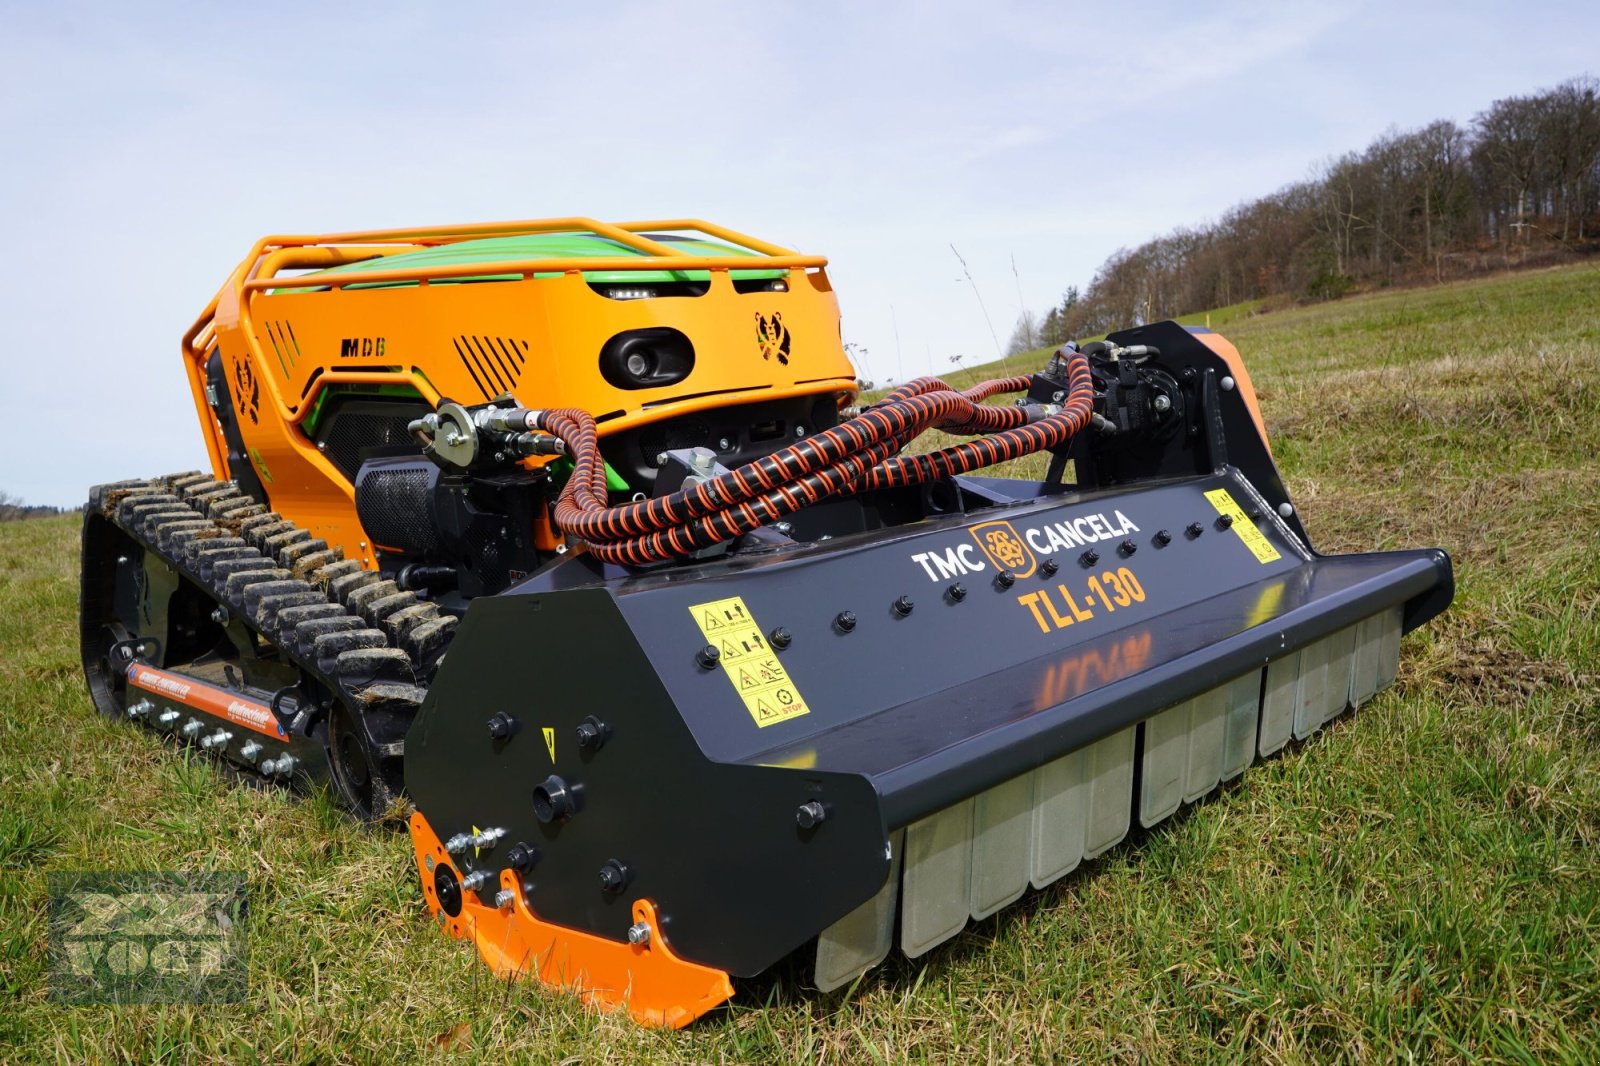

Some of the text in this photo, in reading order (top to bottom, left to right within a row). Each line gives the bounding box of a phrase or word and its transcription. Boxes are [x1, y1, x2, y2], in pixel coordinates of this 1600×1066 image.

[341, 337, 386, 357] MDB
[911, 510, 1140, 582] TMC CANCELA
[1018, 567, 1146, 633] TLL-130
[782, 703, 803, 714] STOP
